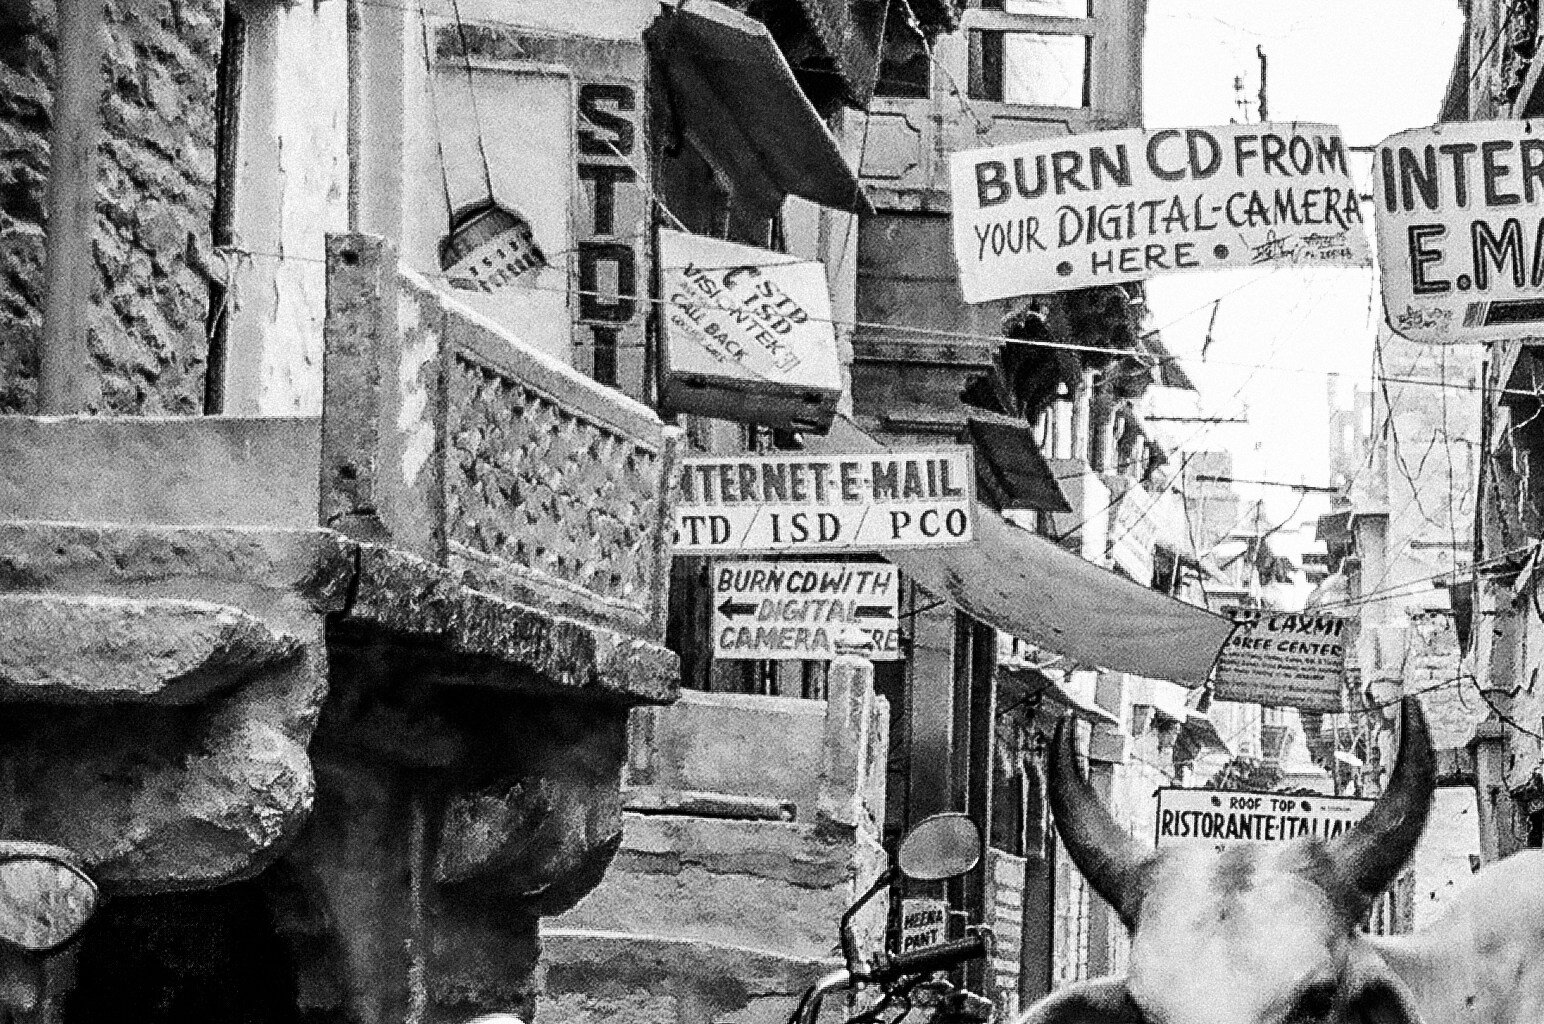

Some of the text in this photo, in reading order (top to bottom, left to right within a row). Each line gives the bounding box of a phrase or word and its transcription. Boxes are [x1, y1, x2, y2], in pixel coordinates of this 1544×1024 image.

[975, 129, 1350, 209] BURN CD FROM
[975, 216, 1047, 261] YOUR
[1091, 242, 1200, 276] HERE
[756, 280, 809, 325] STD
[704, 322, 749, 362] BACK
[770, 512, 841, 544] ISD
[889, 508, 967, 540] PCO
[757, 598, 862, 624] DIGITAL
[1267, 613, 1344, 637] LAXMI
[719, 626, 831, 651] CAMERA
[1229, 796, 1297, 812] ROOF TOP
